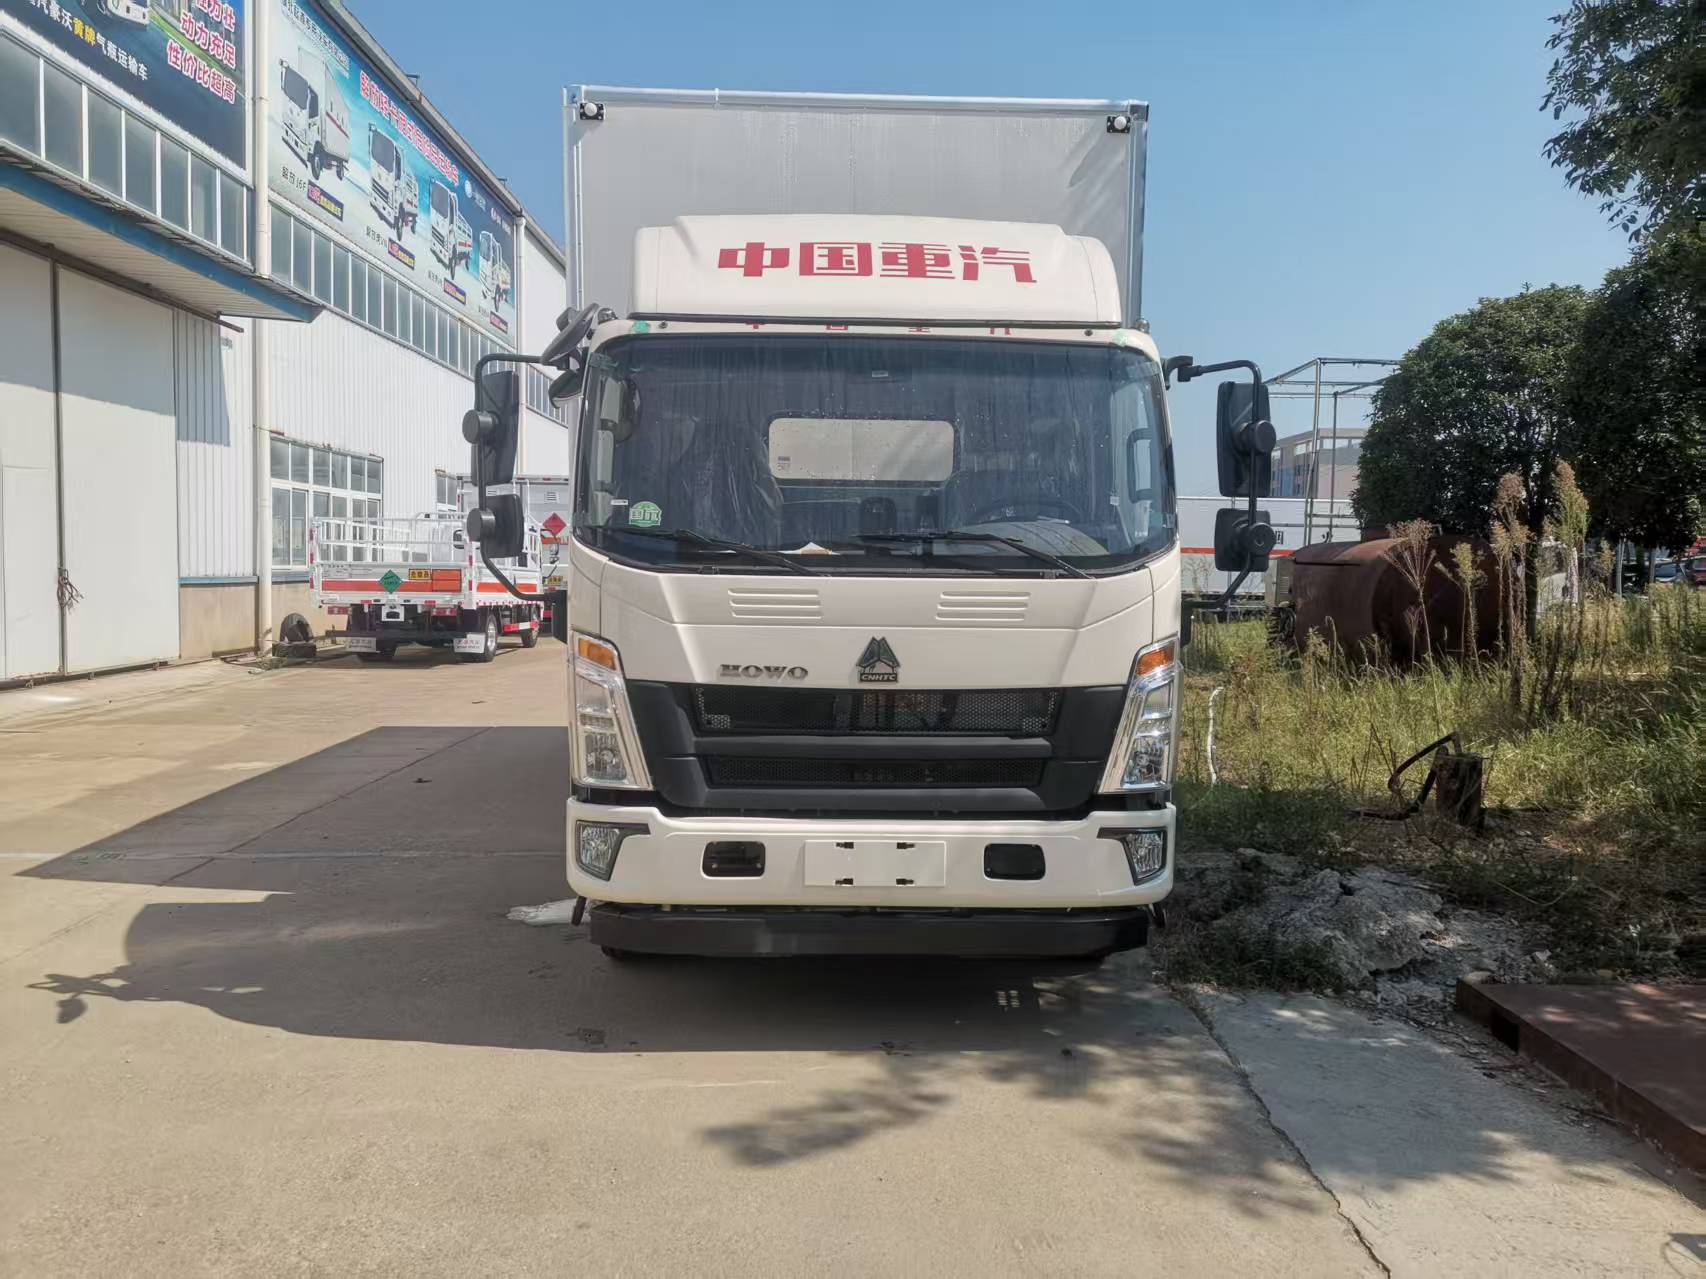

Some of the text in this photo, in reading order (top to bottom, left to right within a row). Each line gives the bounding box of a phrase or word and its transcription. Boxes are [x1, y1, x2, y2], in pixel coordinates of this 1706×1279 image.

[180, 10, 236, 69] 动力充足
[167, 39, 236, 104] 性价比超高
[718, 242, 1037, 282] 中国重汽
[720, 664, 808, 680] HOWO
[860, 673, 897, 682] CNHTC
